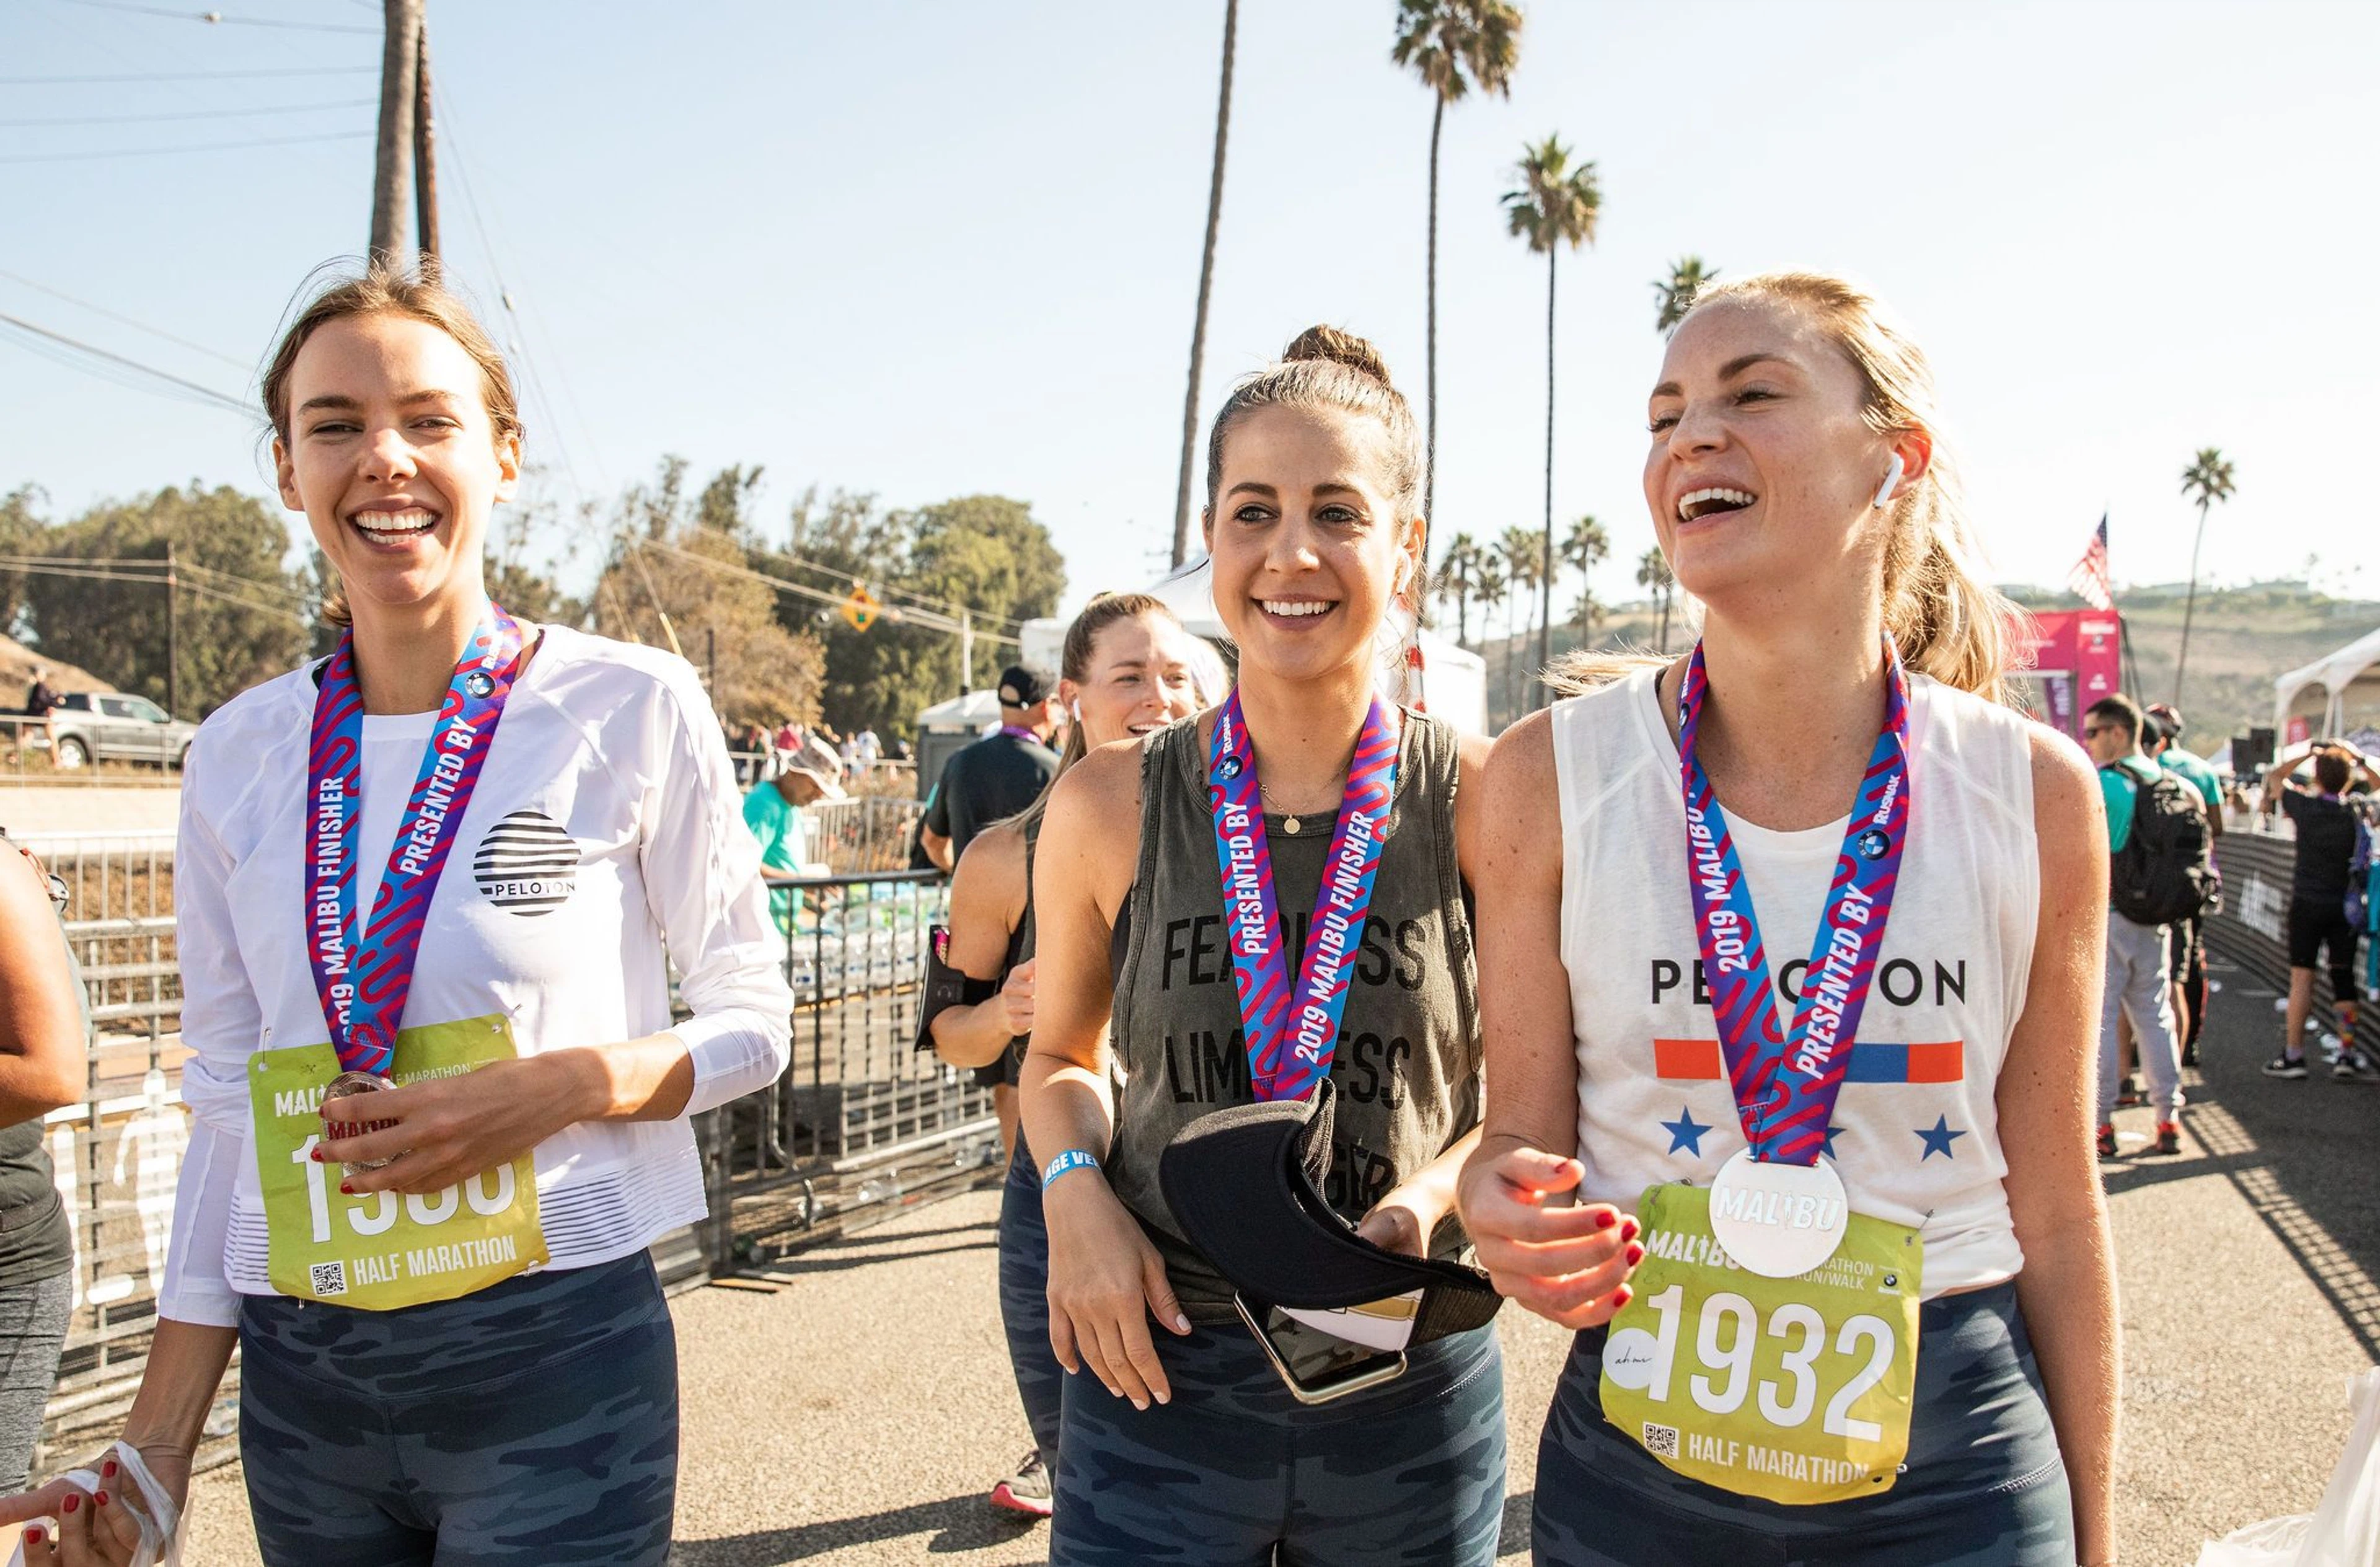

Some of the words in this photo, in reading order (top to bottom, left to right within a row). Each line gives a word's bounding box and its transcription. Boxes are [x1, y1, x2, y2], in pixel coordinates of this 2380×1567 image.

[318, 776, 344, 876] FINISHER
[400, 753, 465, 876] PRESENTED
[446, 715, 477, 750] BY
[1223, 802, 1250, 828] BY
[1872, 774, 1901, 825] RUSNAK
[496, 882, 575, 896] PELOTON
[1329, 810, 1375, 911] FINISHER
[1687, 806, 1732, 901] MALIBU
[317, 885, 350, 975] MALIBU
[1228, 836, 1269, 954] PRESENTED
[1308, 911, 1350, 1003] MALIBU
[1709, 910, 1748, 973] 2019
[330, 983, 354, 1042] 019
[1796, 927, 1862, 1080] PRESENTED
[1840, 882, 1874, 925] BY
[1294, 1005, 1329, 1064] 2019
[1045, 1154, 1069, 1183] AGE
[353, 1253, 401, 1286] HALF
[407, 1234, 517, 1277] MARATHON
[1647, 1284, 1895, 1442] 1932
[1689, 1434, 1740, 1467] HALF
[1747, 1444, 1870, 1485] MARATHON
